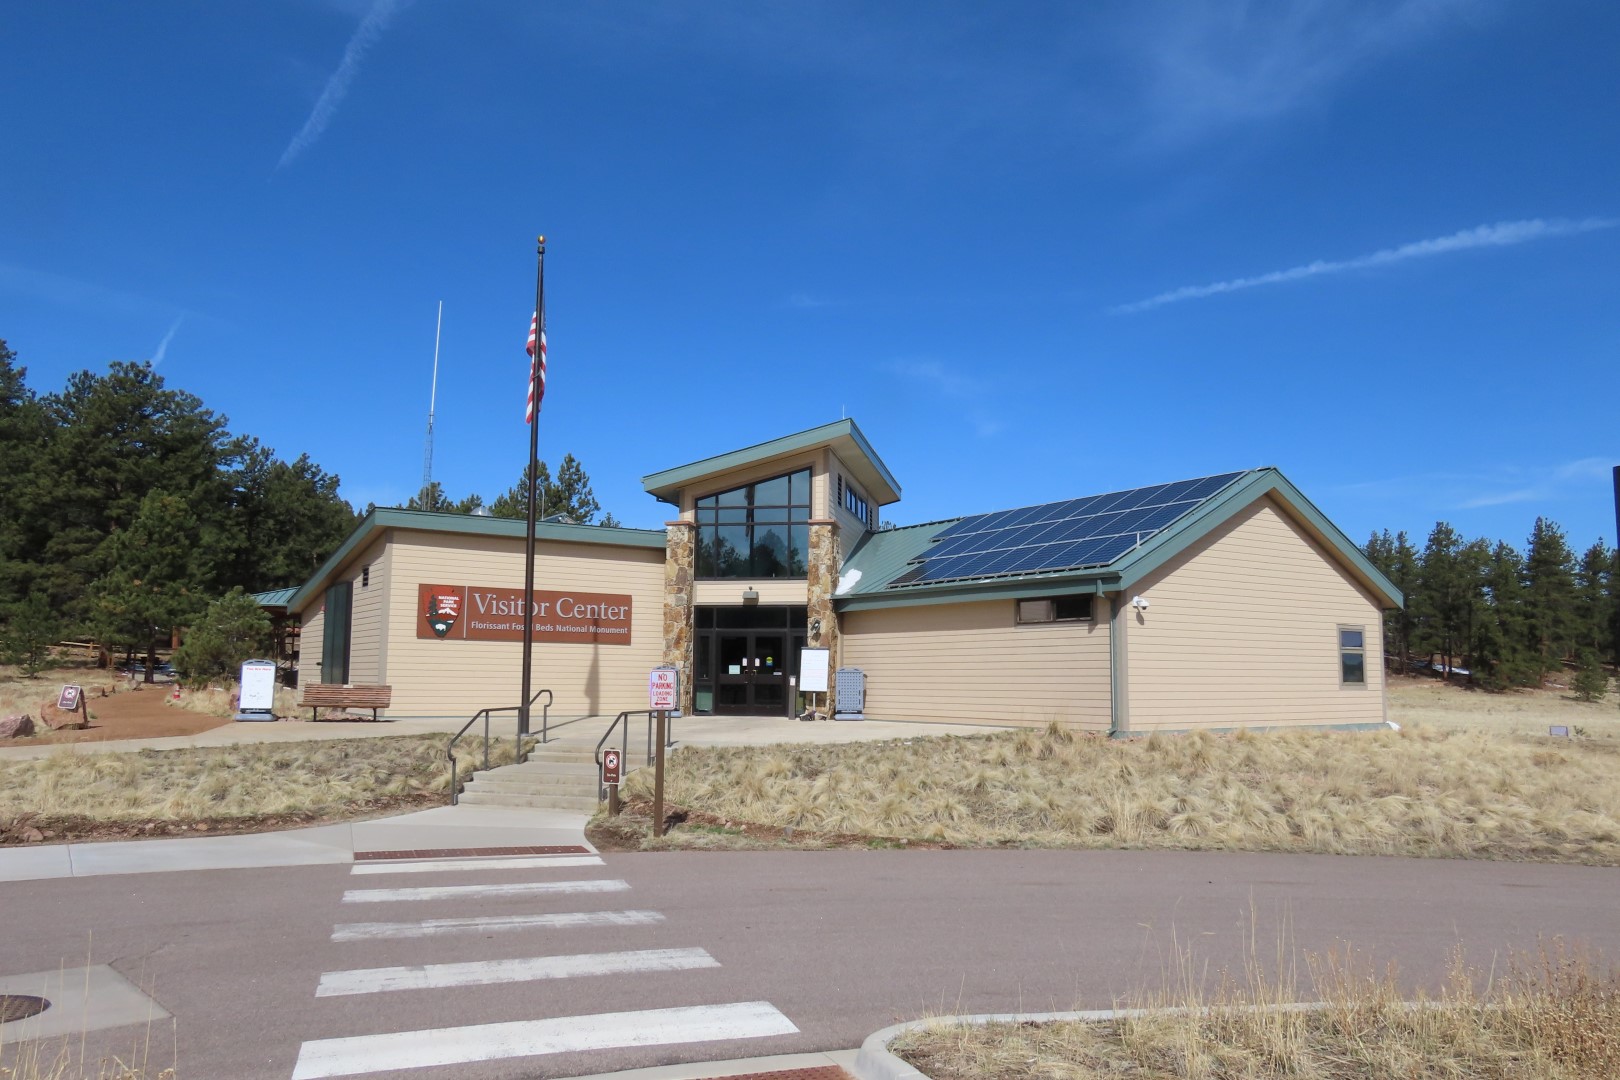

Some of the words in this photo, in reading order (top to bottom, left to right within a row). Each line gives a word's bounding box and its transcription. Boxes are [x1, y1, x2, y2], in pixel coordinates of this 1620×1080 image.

[556, 597, 629, 620] Center
[471, 621, 510, 630] Florissant
[512, 622, 534, 631] Fosl
[535, 624, 554, 632] Beds
[556, 624, 588, 633] National
[589, 626, 628, 634] Monument
